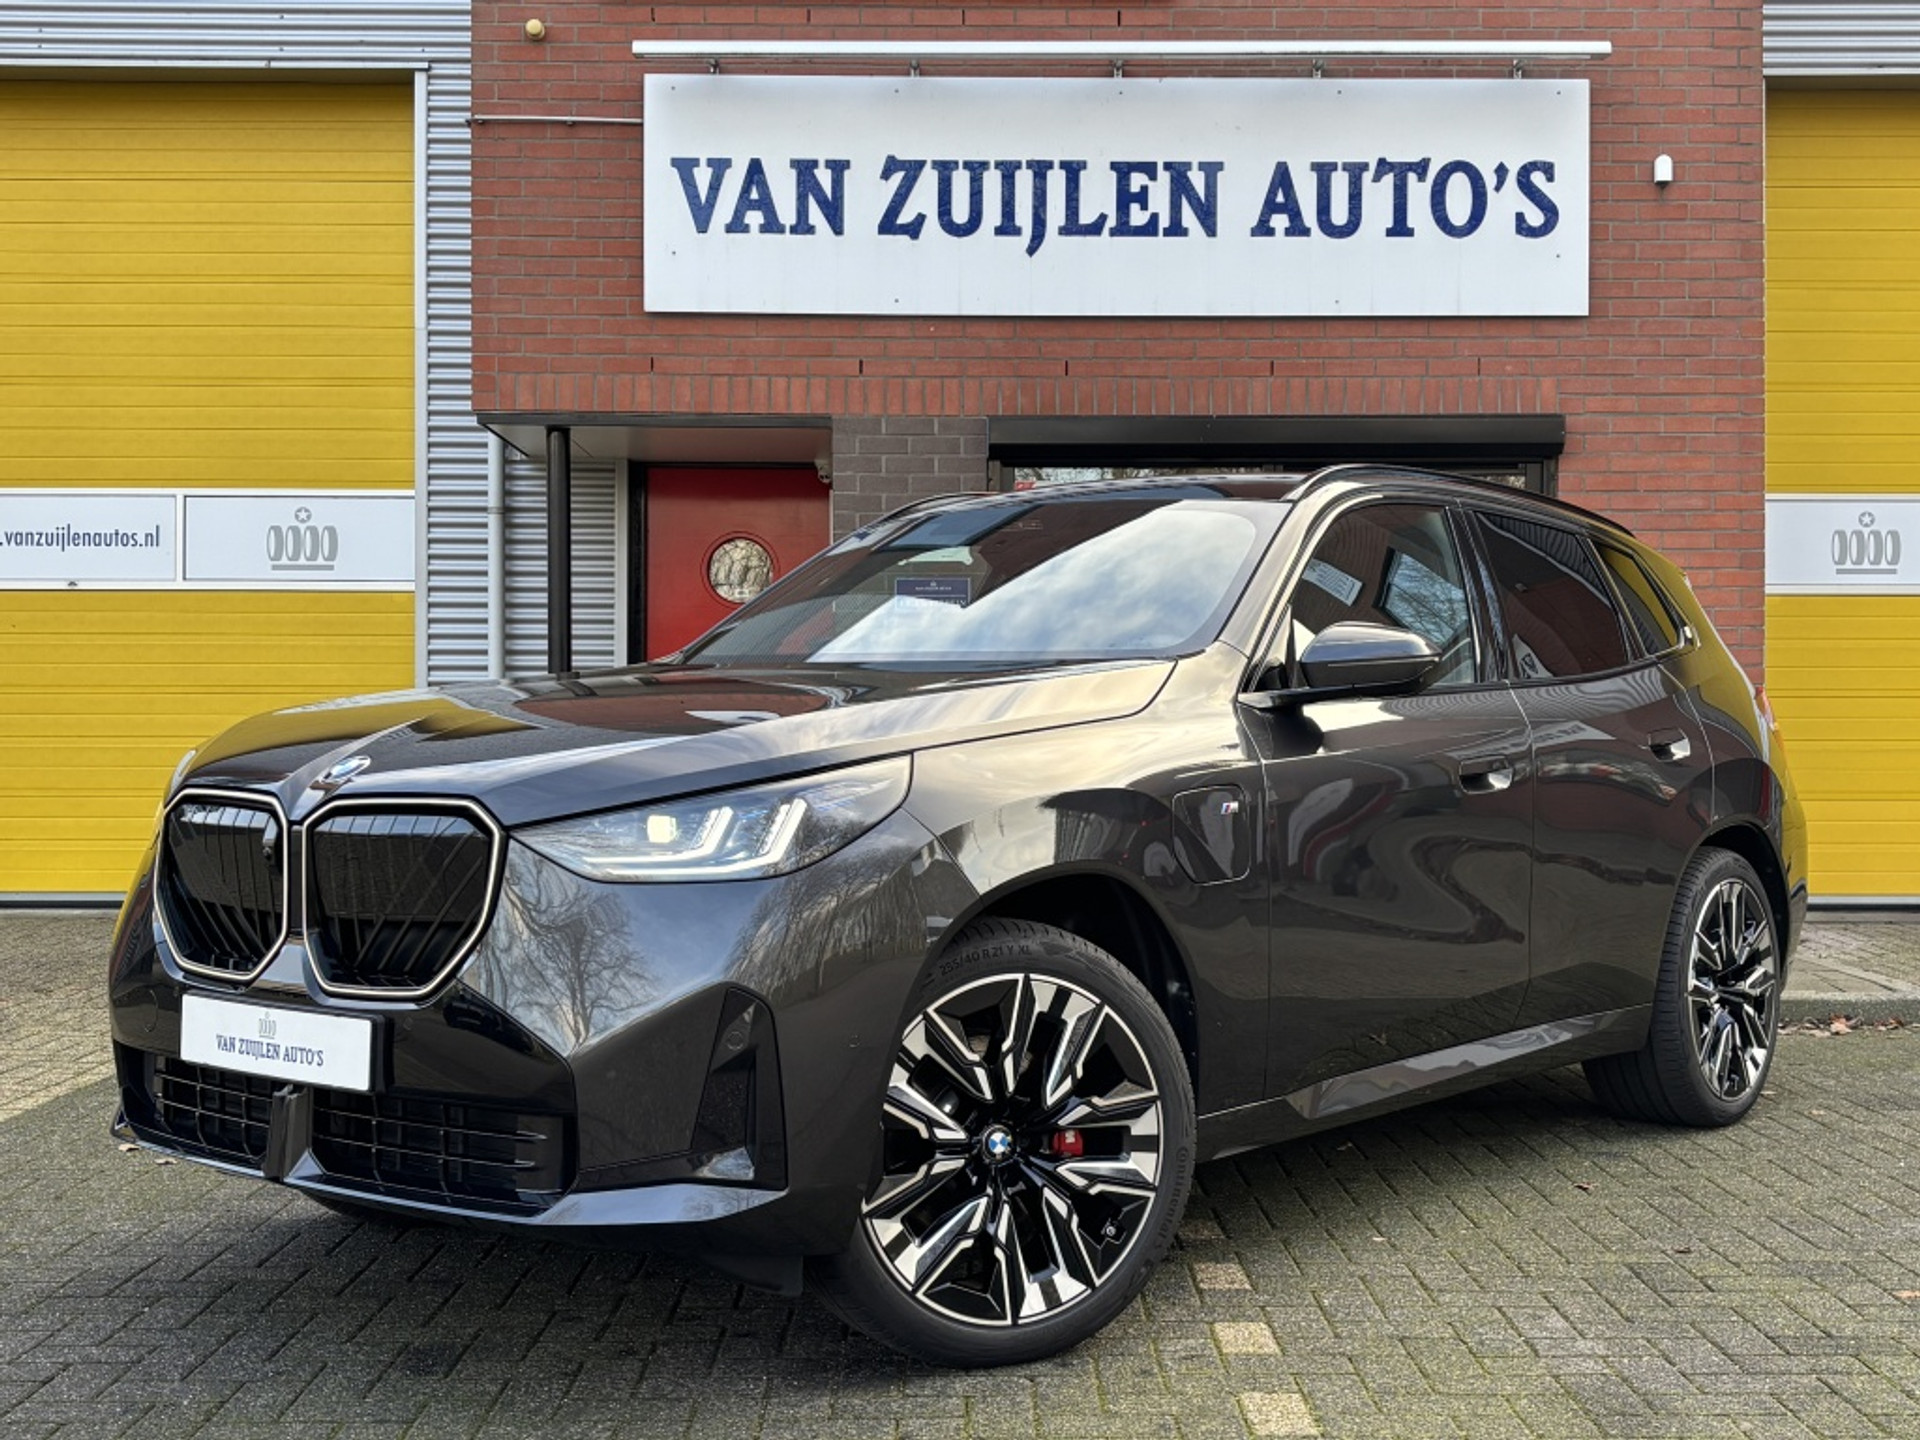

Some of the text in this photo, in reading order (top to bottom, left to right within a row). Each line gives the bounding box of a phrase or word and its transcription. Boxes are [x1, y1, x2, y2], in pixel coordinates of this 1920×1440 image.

[671, 154, 1560, 257] VAN ZUIJLEN AUTO'S
[0, 523, 160, 552] .vanzuijlenautos.nl
[216, 1034, 324, 1067] VAN ZUIJLEN AUTO'S
